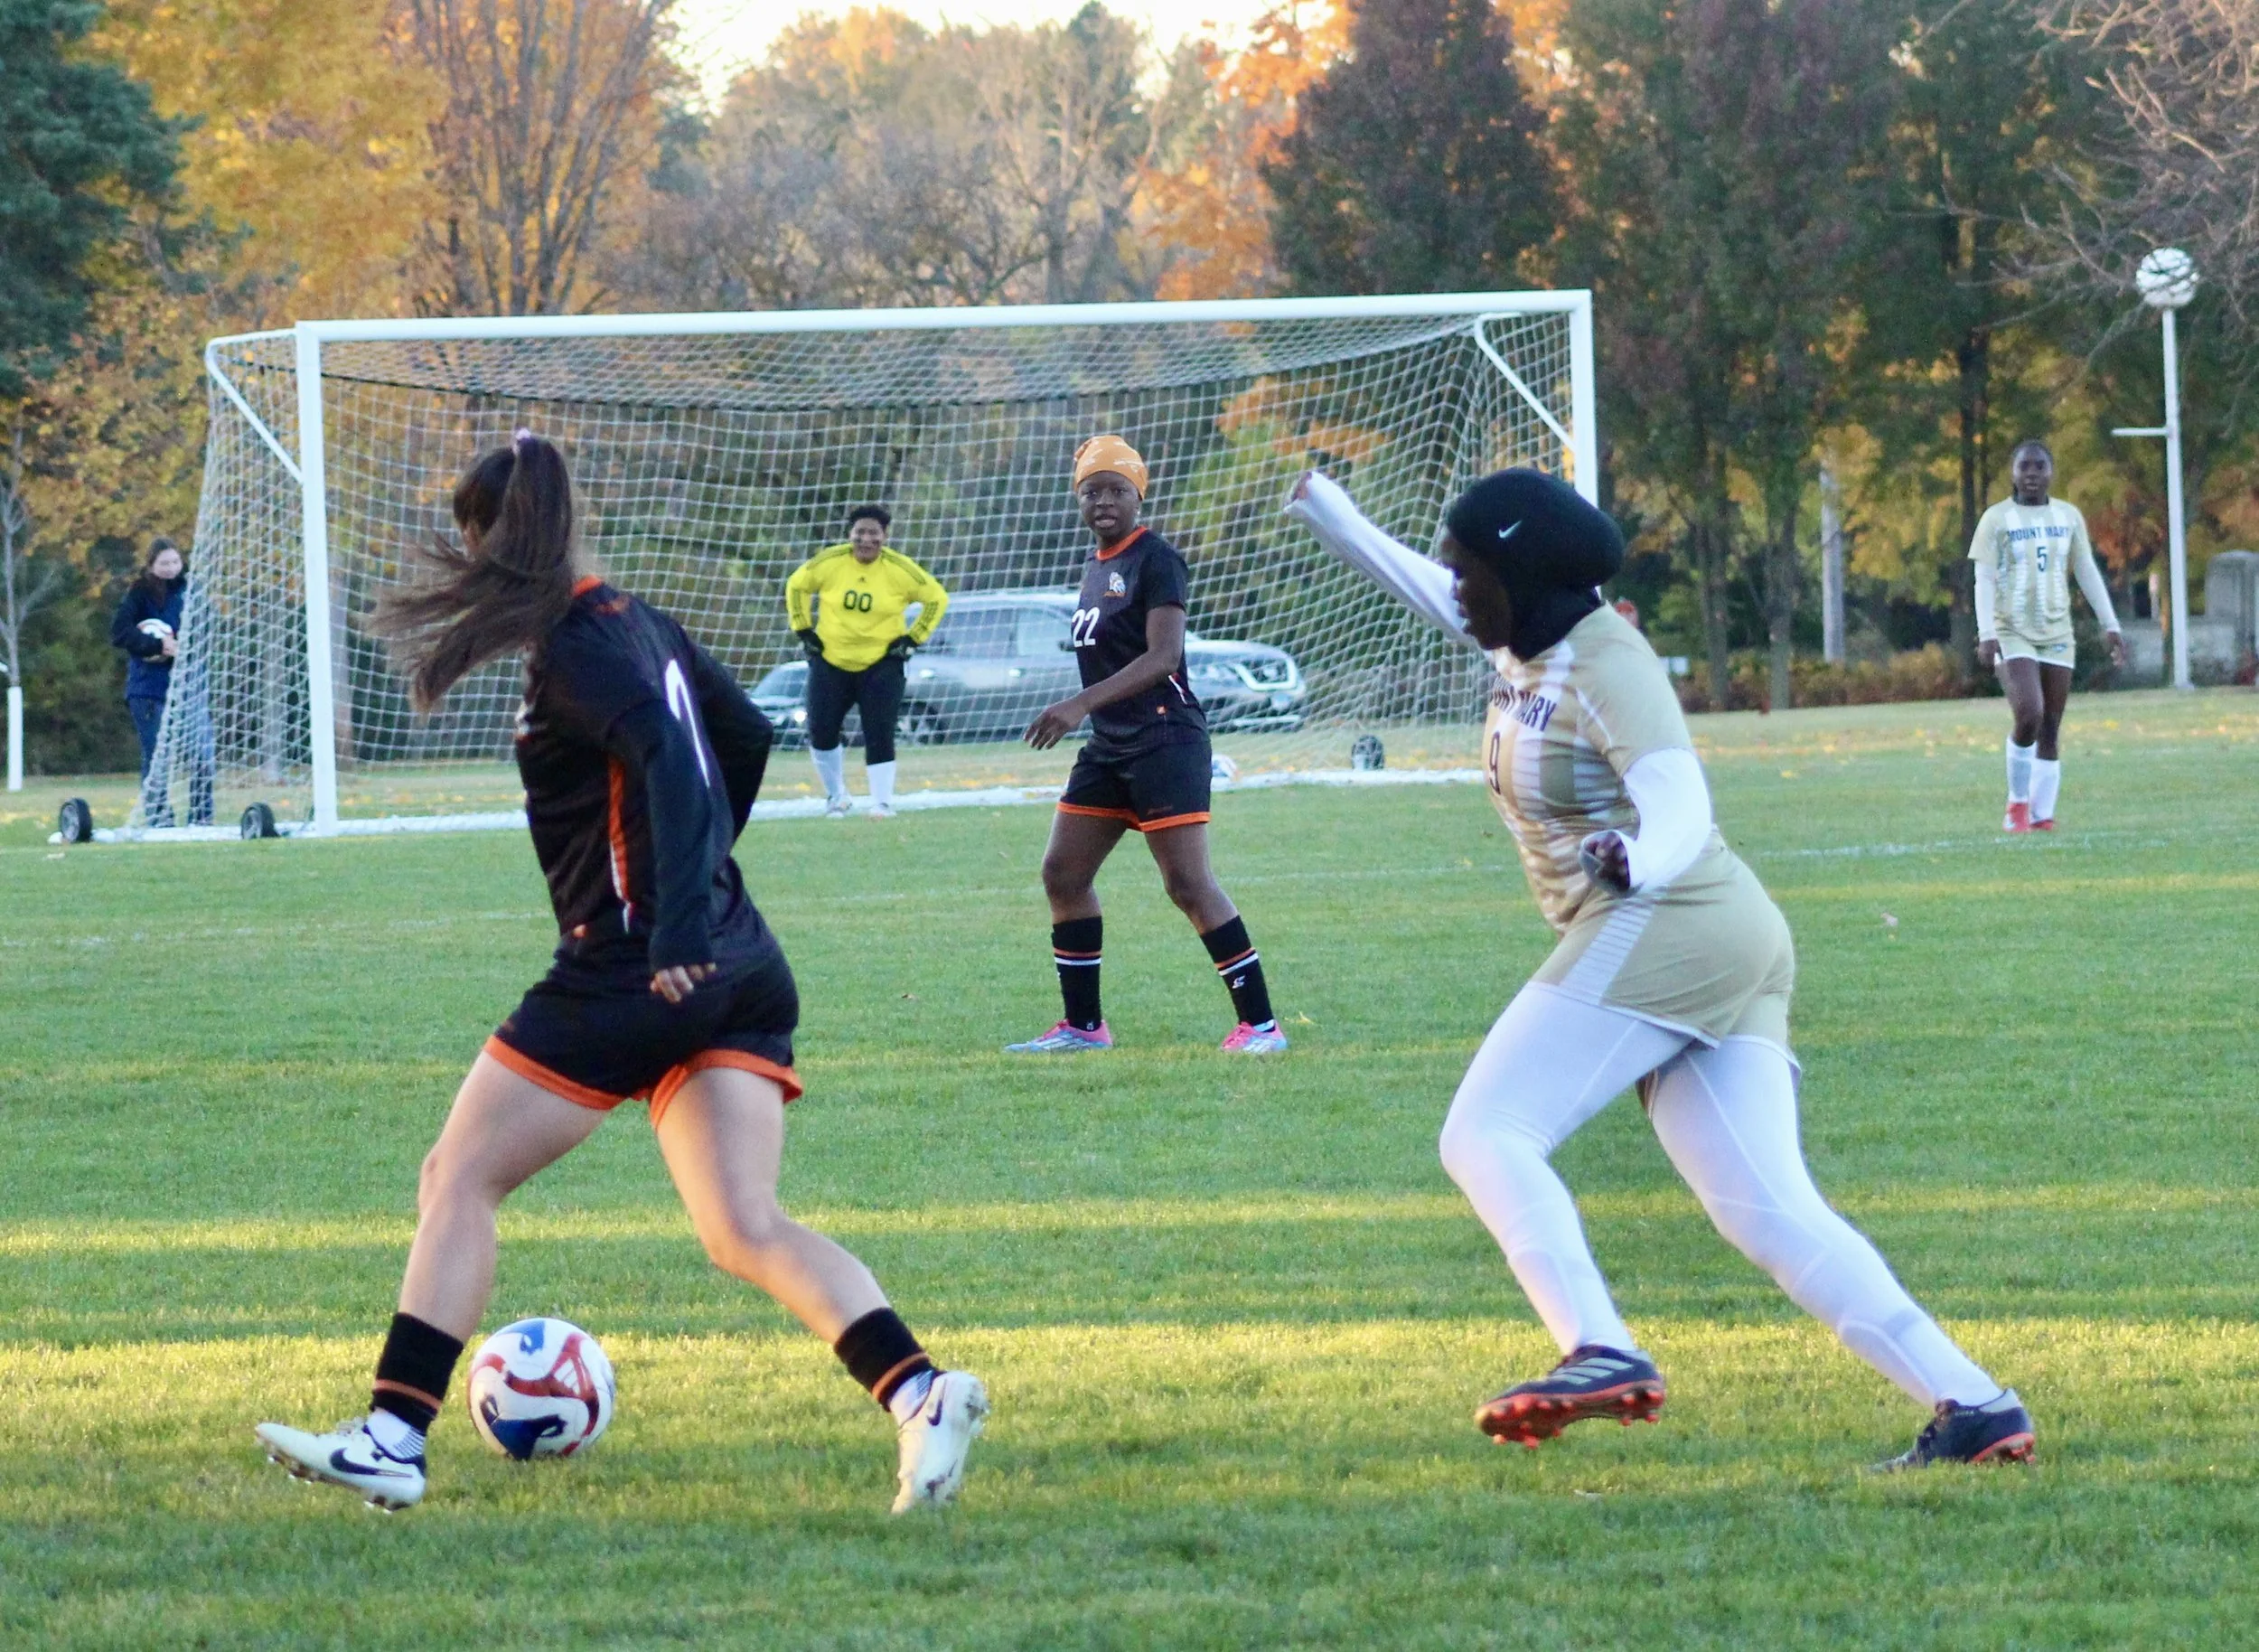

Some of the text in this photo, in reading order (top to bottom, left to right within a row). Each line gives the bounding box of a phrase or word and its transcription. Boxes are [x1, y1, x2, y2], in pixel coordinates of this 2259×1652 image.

[2007, 527, 2042, 542] MOUNT
[2036, 546, 2047, 572] 5
[843, 590, 872, 613] 00
[1071, 606, 1101, 648] 22
